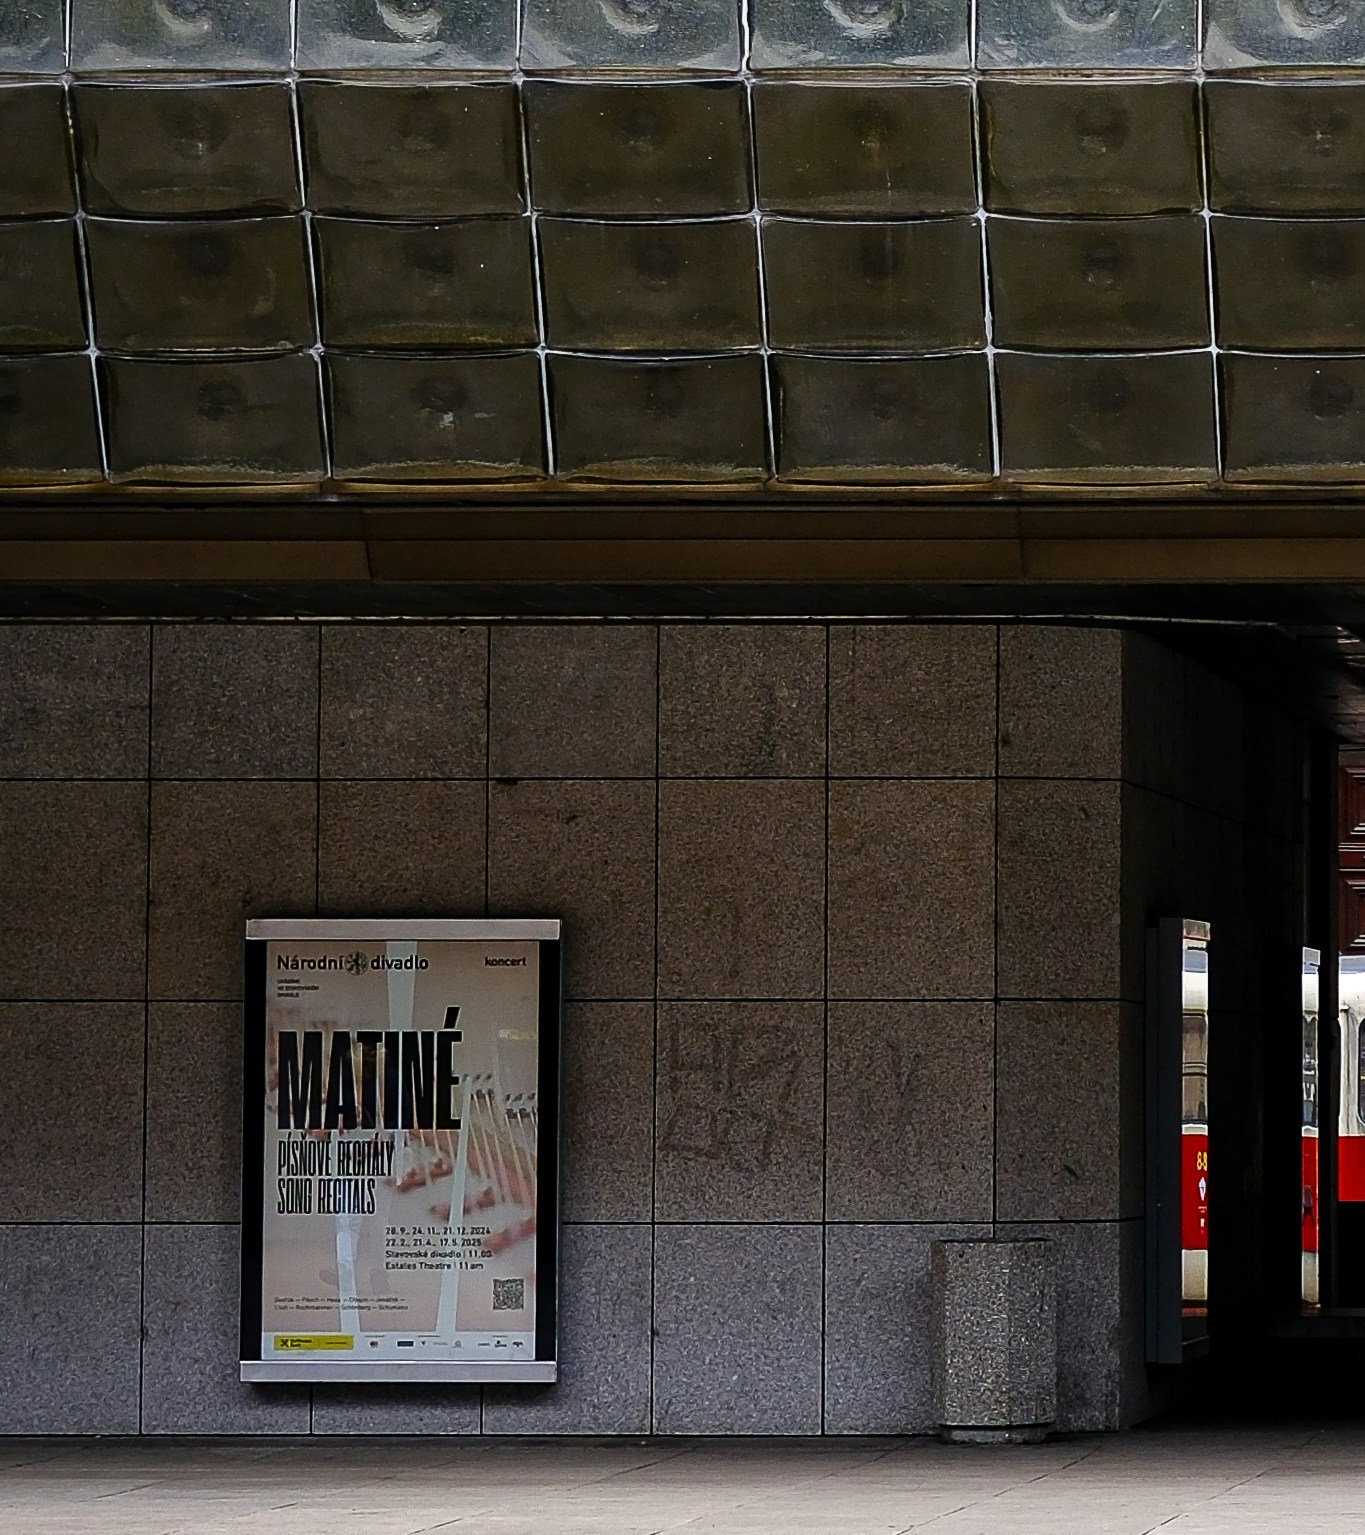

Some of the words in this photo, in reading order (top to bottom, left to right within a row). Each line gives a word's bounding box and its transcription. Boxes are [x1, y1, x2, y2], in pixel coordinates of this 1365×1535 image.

[277, 954, 344, 970] Národní
[370, 954, 429, 970] divadlo
[484, 956, 527, 967] koncert
[277, 1005, 463, 1129] MATINÉ
[277, 1131, 332, 1177] PÍSŇOVÉ
[338, 1131, 395, 1177] RECITÁLY
[277, 1178, 312, 1215] SONG
[317, 1178, 376, 1215] RECITALS
[420, 1262, 452, 1270] Theatre
